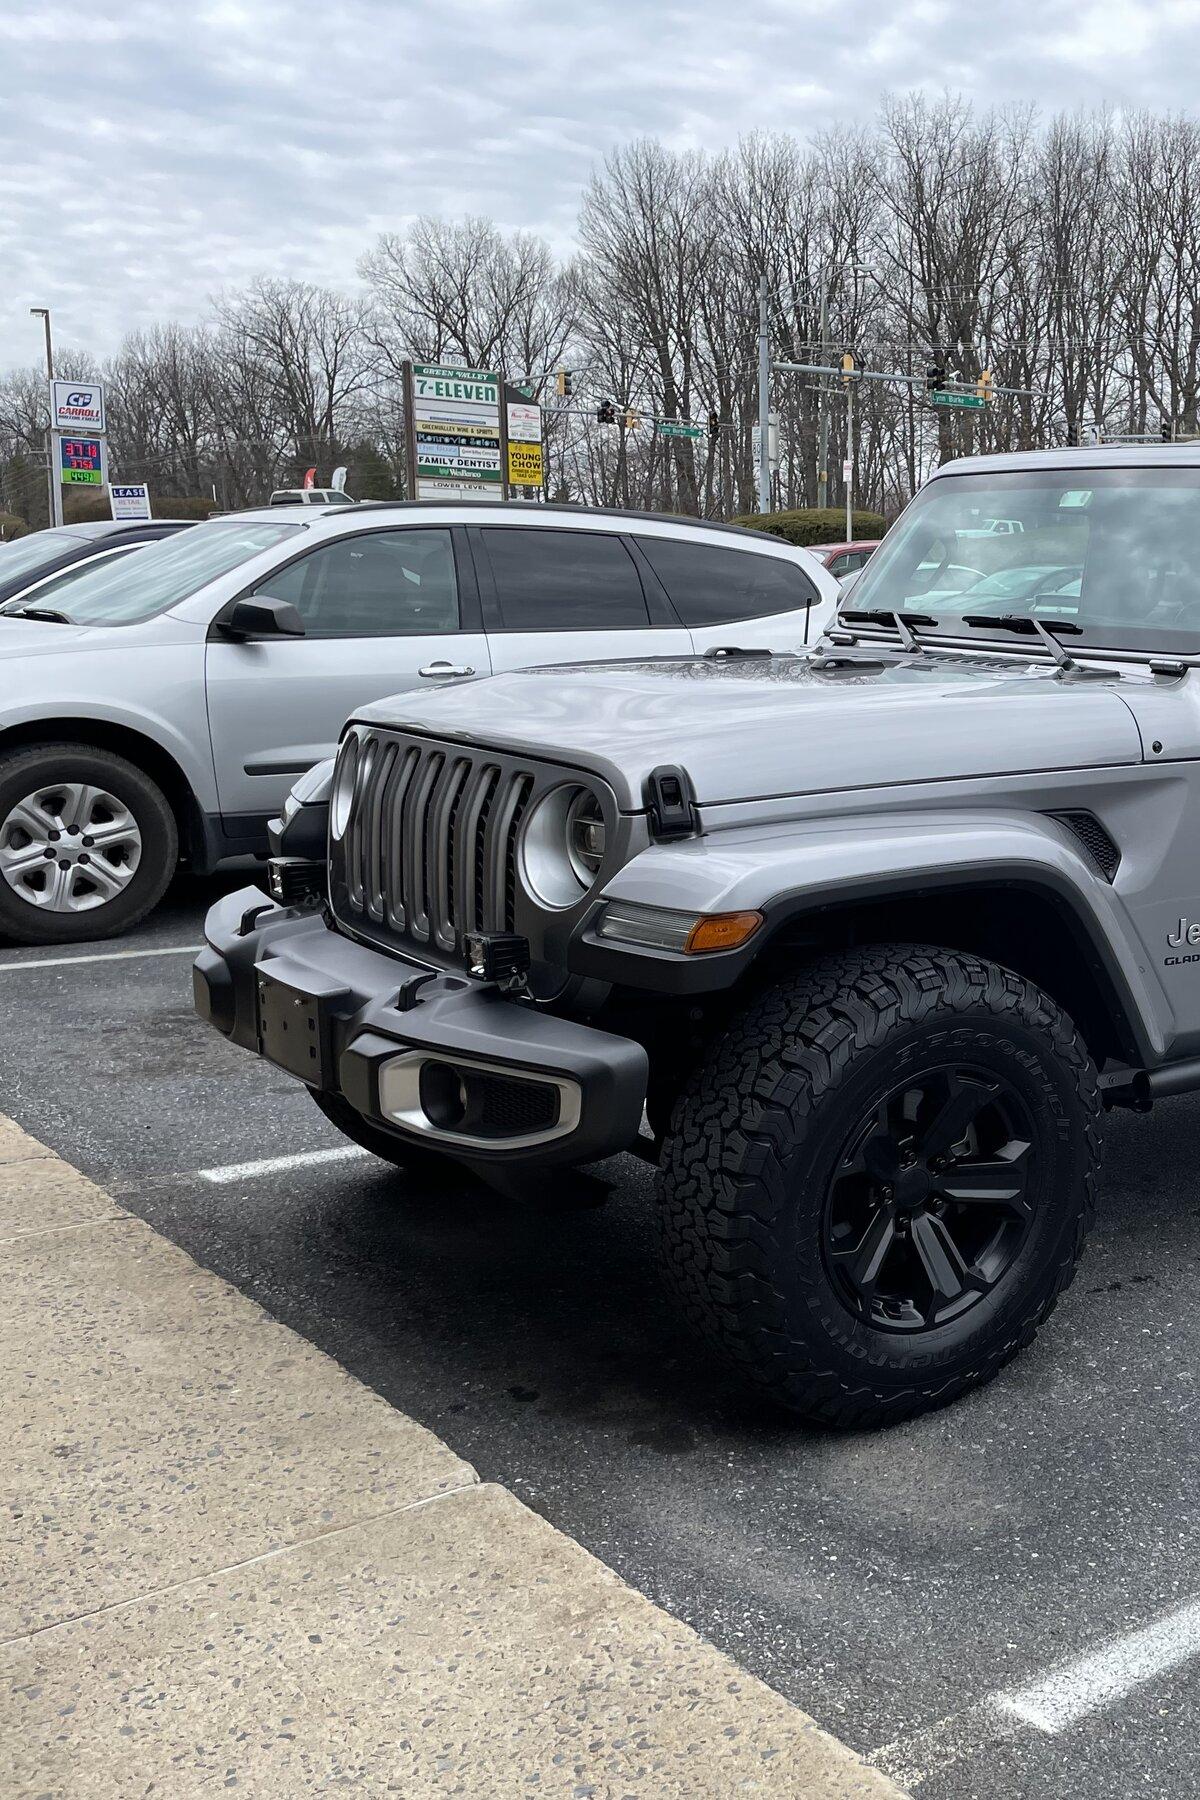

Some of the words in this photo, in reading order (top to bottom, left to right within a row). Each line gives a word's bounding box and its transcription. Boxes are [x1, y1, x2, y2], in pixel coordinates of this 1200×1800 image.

[422, 368, 454, 377] GREEN
[456, 371, 489, 380] VALLEY
[58, 406, 100, 417] CARROLL
[457, 426, 469, 434] WINE
[510, 452, 541, 461] YOUNG
[418, 456, 455, 466] FAMILY
[457, 459, 498, 468] DENTIST
[511, 460, 541, 469] CHOW
[113, 488, 145, 497] LEASE
